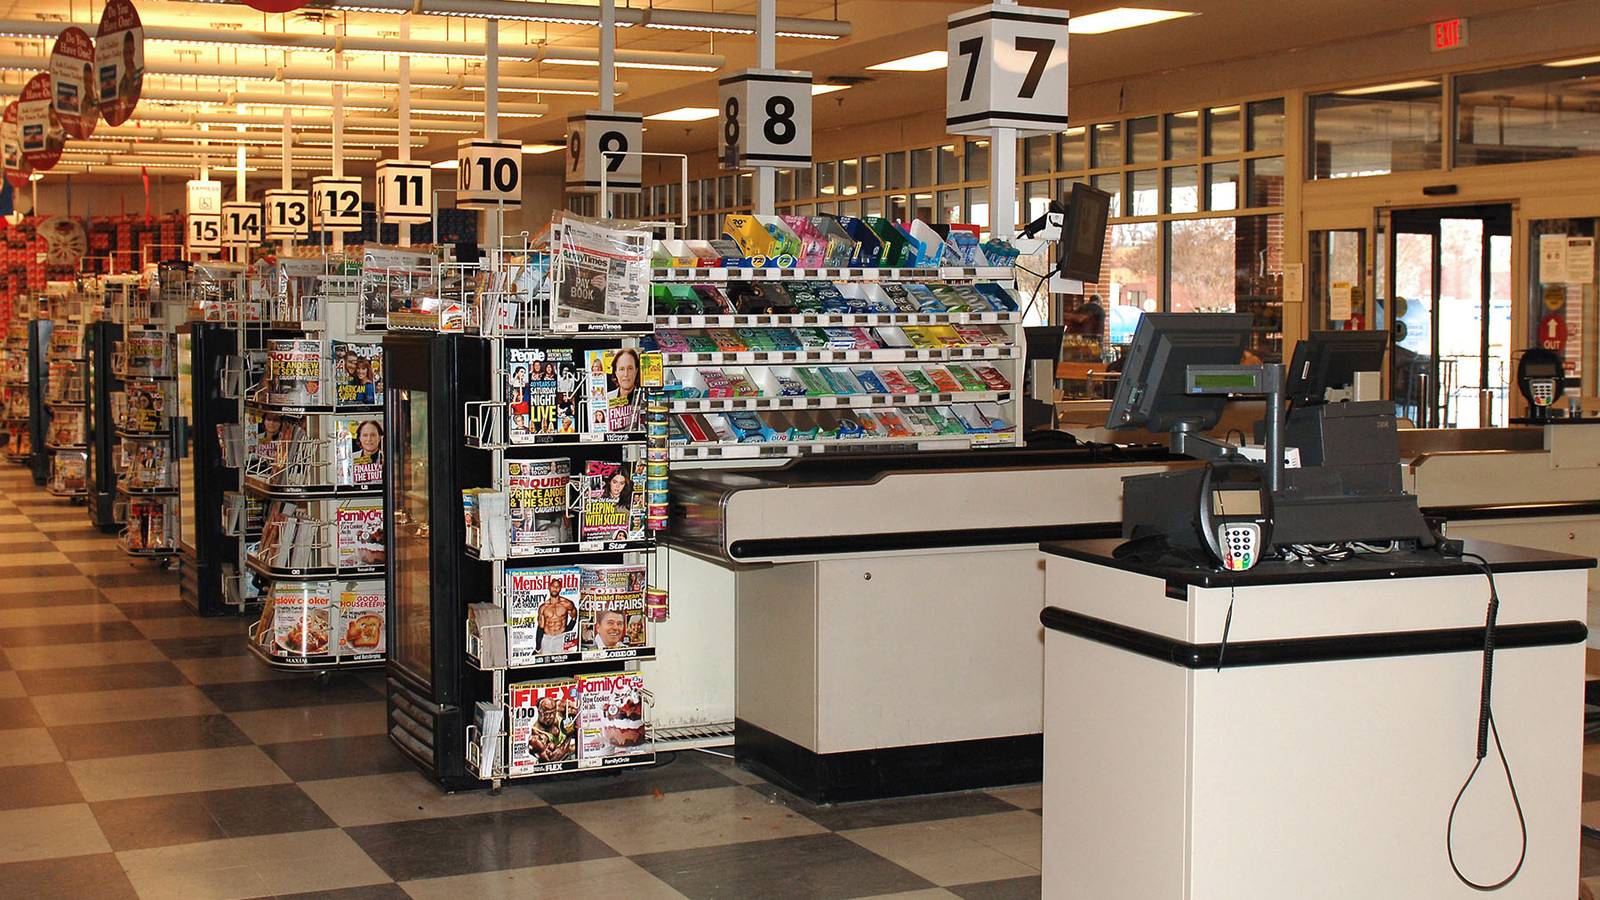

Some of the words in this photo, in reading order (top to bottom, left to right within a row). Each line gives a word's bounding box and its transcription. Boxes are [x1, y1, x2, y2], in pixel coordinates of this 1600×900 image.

[1435, 19, 1461, 48] EXIT
[959, 36, 984, 102] 7
[1015, 36, 1056, 99] 7
[725, 97, 741, 146] 8
[763, 95, 797, 145] 8
[570, 130, 582, 173] 9
[598, 130, 629, 173] 9
[458, 157, 472, 191] 10
[476, 156, 519, 193] 10
[393, 175, 424, 207] 11
[275, 201, 306, 226] 13
[325, 190, 361, 218] 12
[193, 220, 219, 242] 15
[229, 212, 259, 236] 14
[570, 286, 594, 300] BOOK
[575, 278, 590, 290] PAY
[347, 343, 383, 360] People
[510, 348, 546, 363] People
[1543, 340, 1561, 350] OUT
[530, 394, 557, 406] NIGHT
[530, 405, 557, 423] LIVE
[353, 472, 367, 483] THE
[537, 497, 554, 507] SEX
[608, 542, 627, 550] Star
[275, 596, 296, 605] slow
[607, 598, 644, 611] AFFAIRS
[510, 685, 577, 708] FLEX
[545, 763, 563, 772] FLEX
